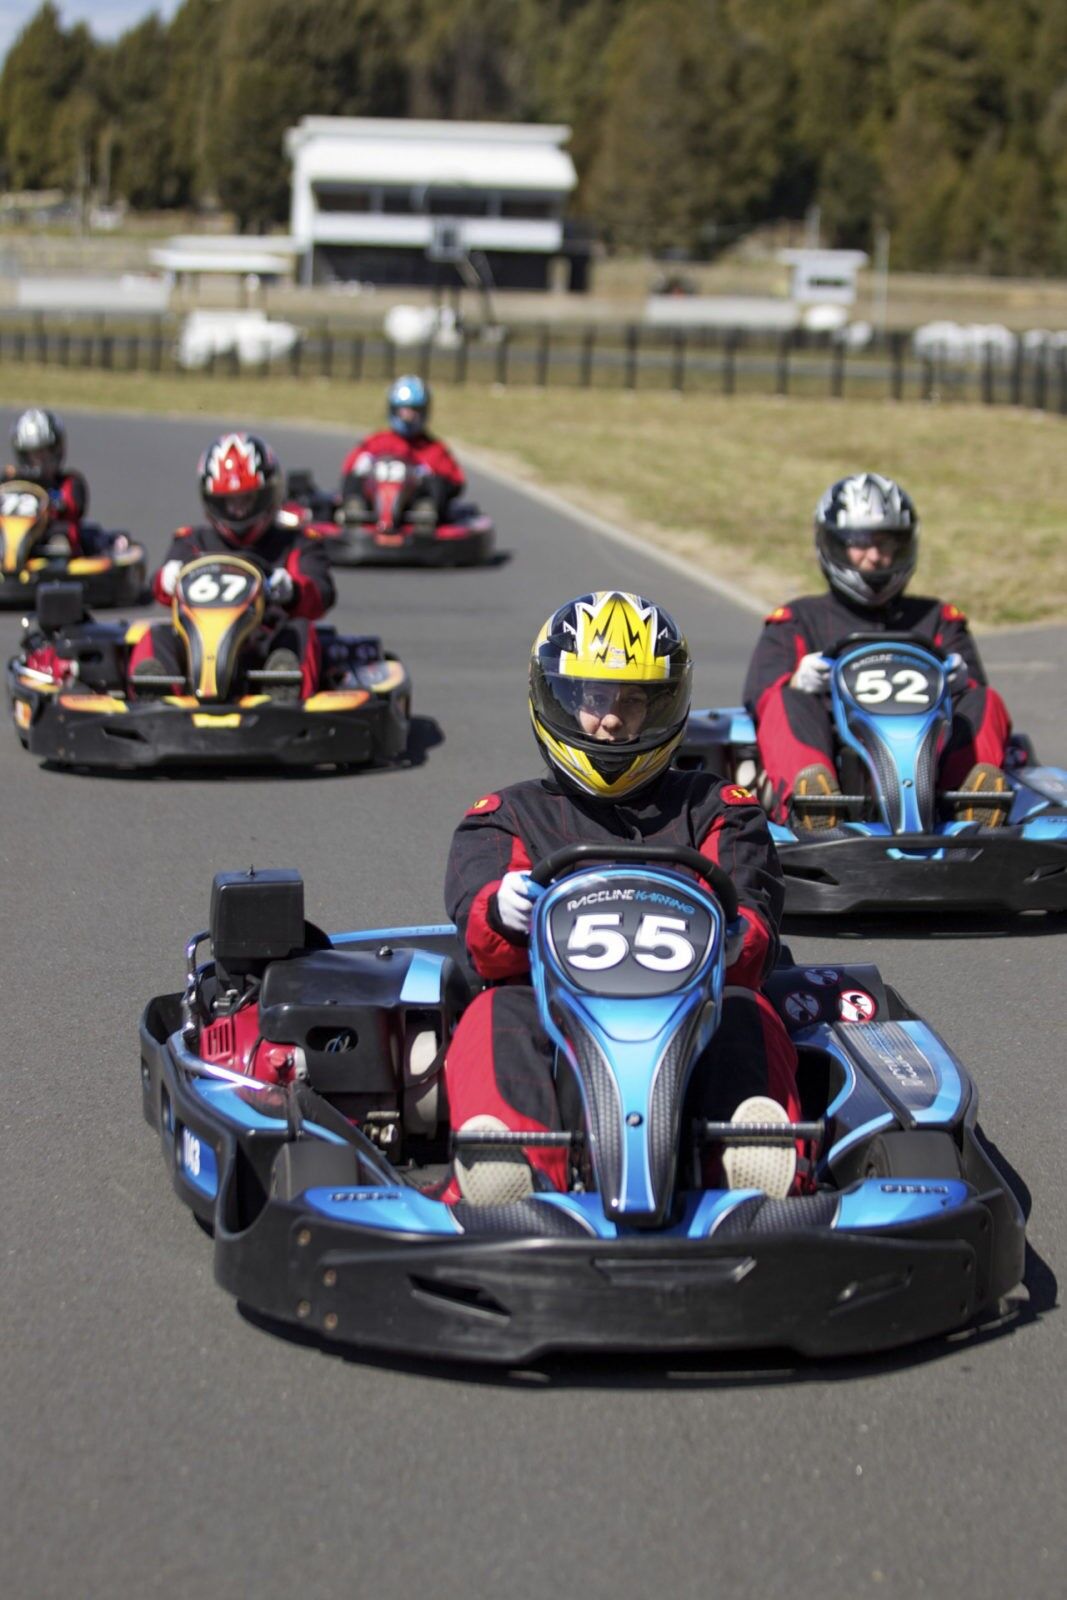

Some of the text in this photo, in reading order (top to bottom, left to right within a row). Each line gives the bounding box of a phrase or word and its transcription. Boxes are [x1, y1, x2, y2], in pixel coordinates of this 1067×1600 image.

[188, 574, 247, 602] 67
[855, 670, 930, 704] 52
[567, 889, 695, 915] RACELINE KARTING
[567, 912, 695, 972] 55
